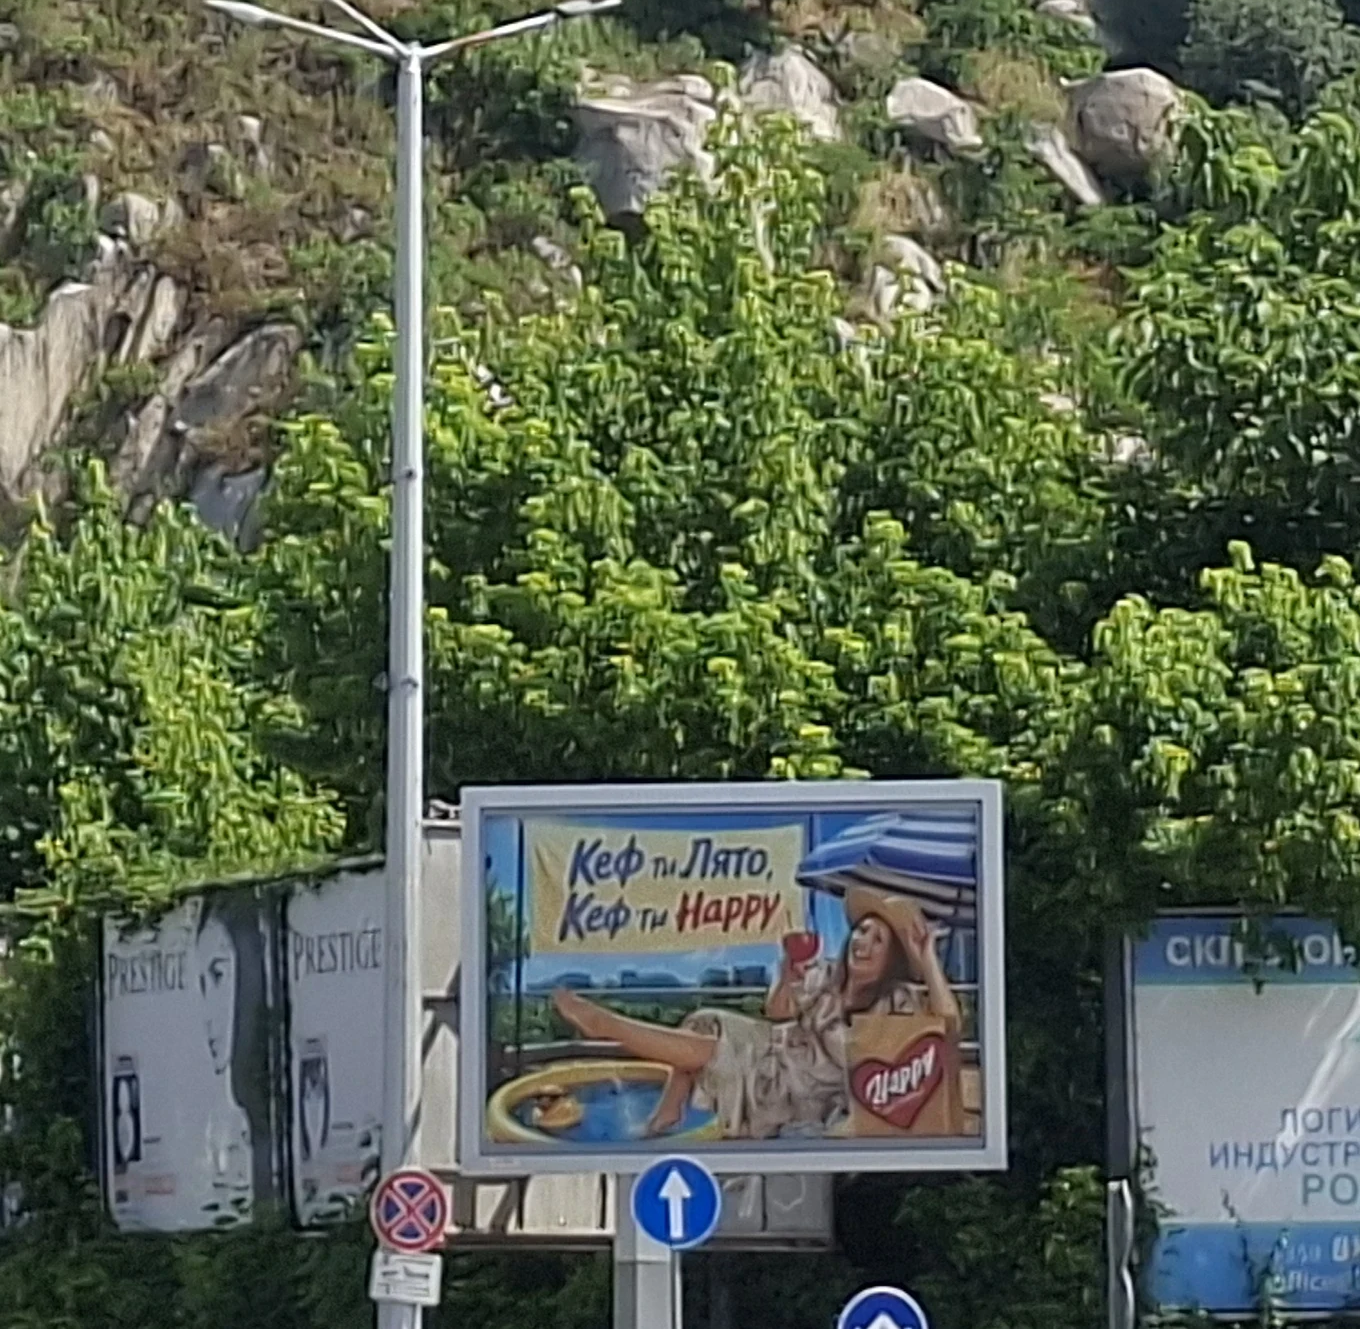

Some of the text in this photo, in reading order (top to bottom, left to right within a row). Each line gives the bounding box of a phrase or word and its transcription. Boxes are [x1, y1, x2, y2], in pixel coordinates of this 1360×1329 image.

[569, 834, 773, 888] Кеф ти Лято,
[558, 892, 632, 942] Кеф
[639, 907, 669, 932] ти
